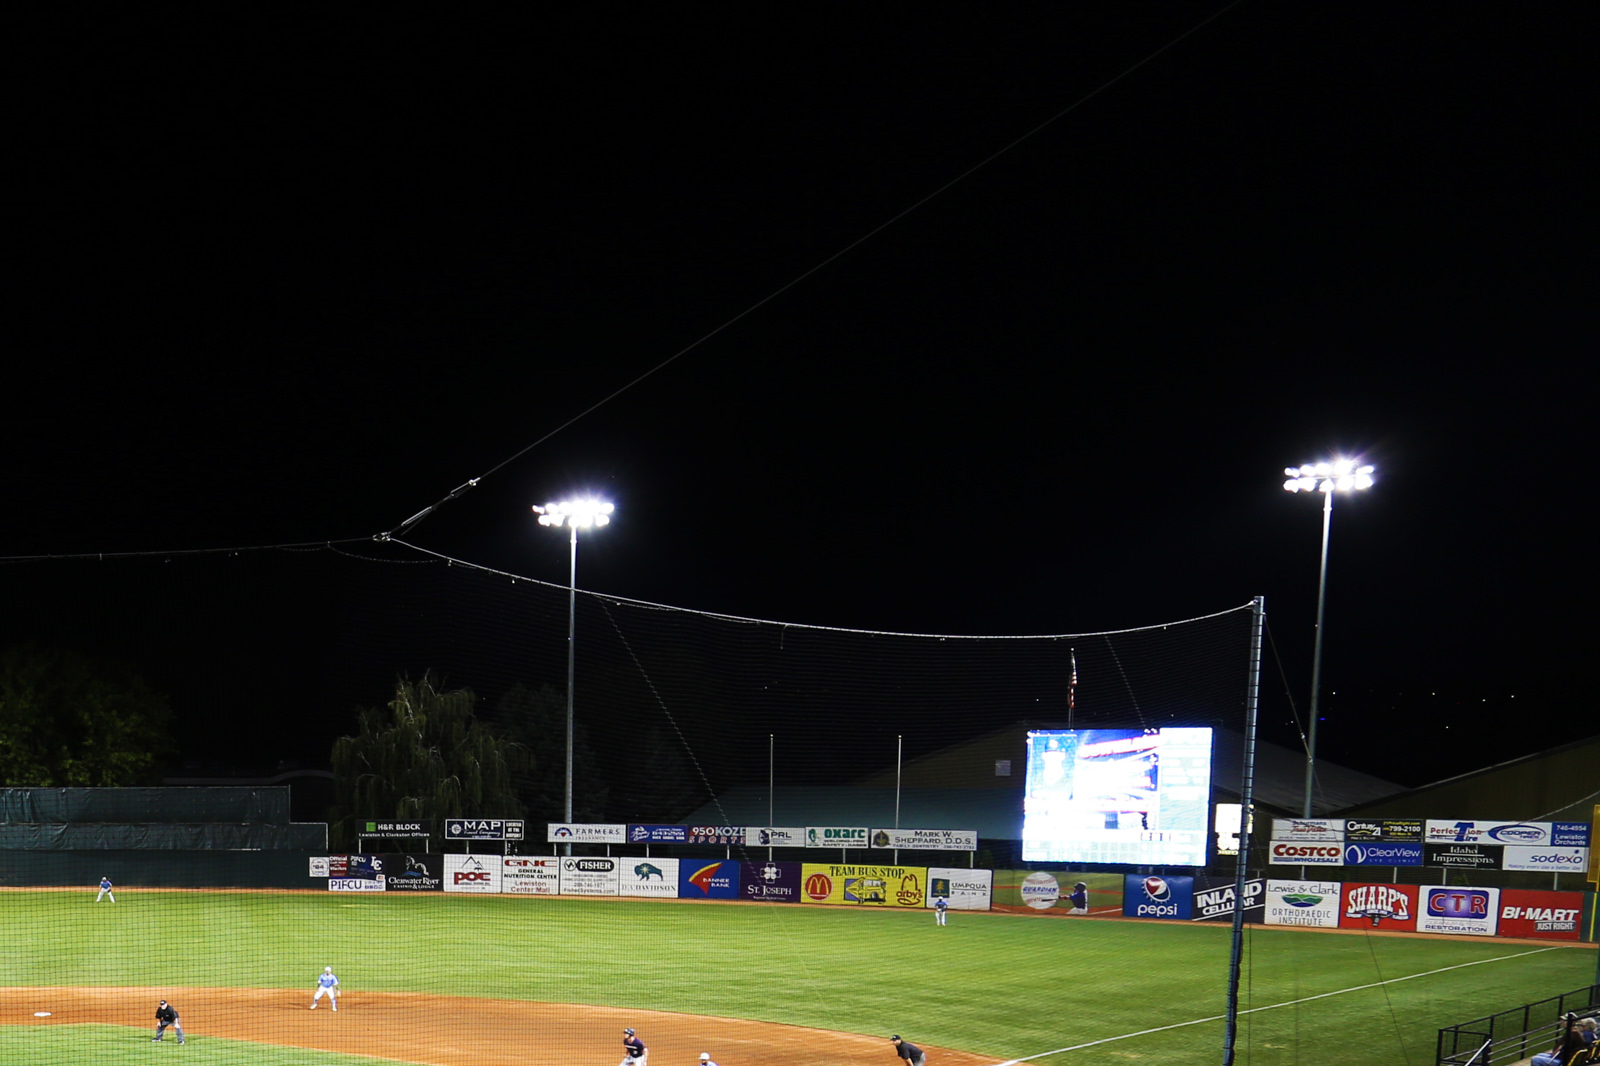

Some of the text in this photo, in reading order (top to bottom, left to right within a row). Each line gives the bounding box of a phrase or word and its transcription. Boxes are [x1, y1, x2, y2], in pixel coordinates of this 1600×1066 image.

[464, 821, 501, 830] MAP
[692, 827, 714, 836] 950
[715, 827, 746, 836] KOZE
[1273, 844, 1341, 857] COSTCO
[1367, 848, 1420, 857] ClearView
[1451, 846, 1478, 854] Idaho
[504, 859, 557, 867] GNC
[1433, 854, 1495, 864] Impressions
[1530, 854, 1583, 864] sodexo
[580, 861, 611, 869] FISHER
[829, 866, 905, 879] TEAM BUS STOP
[331, 880, 362, 890] P1FCU
[388, 876, 422, 884] Clearwater
[762, 885, 792, 896] JOSEPH
[952, 882, 987, 890] UMPQUA
[1023, 886, 1058, 894] GUARDIAN
[1268, 884, 1338, 895] Lewis & Clark
[1348, 886, 1408, 916] SHARP'S
[1430, 894, 1487, 914] CTR
[1137, 903, 1178, 917] pepsi
[1272, 908, 1331, 918] ORTHOPAEDIC
[1279, 916, 1323, 926] INSTITUTE
[1425, 924, 1487, 932] RESTORATION
[1536, 922, 1574, 931] JUST RIGHT
